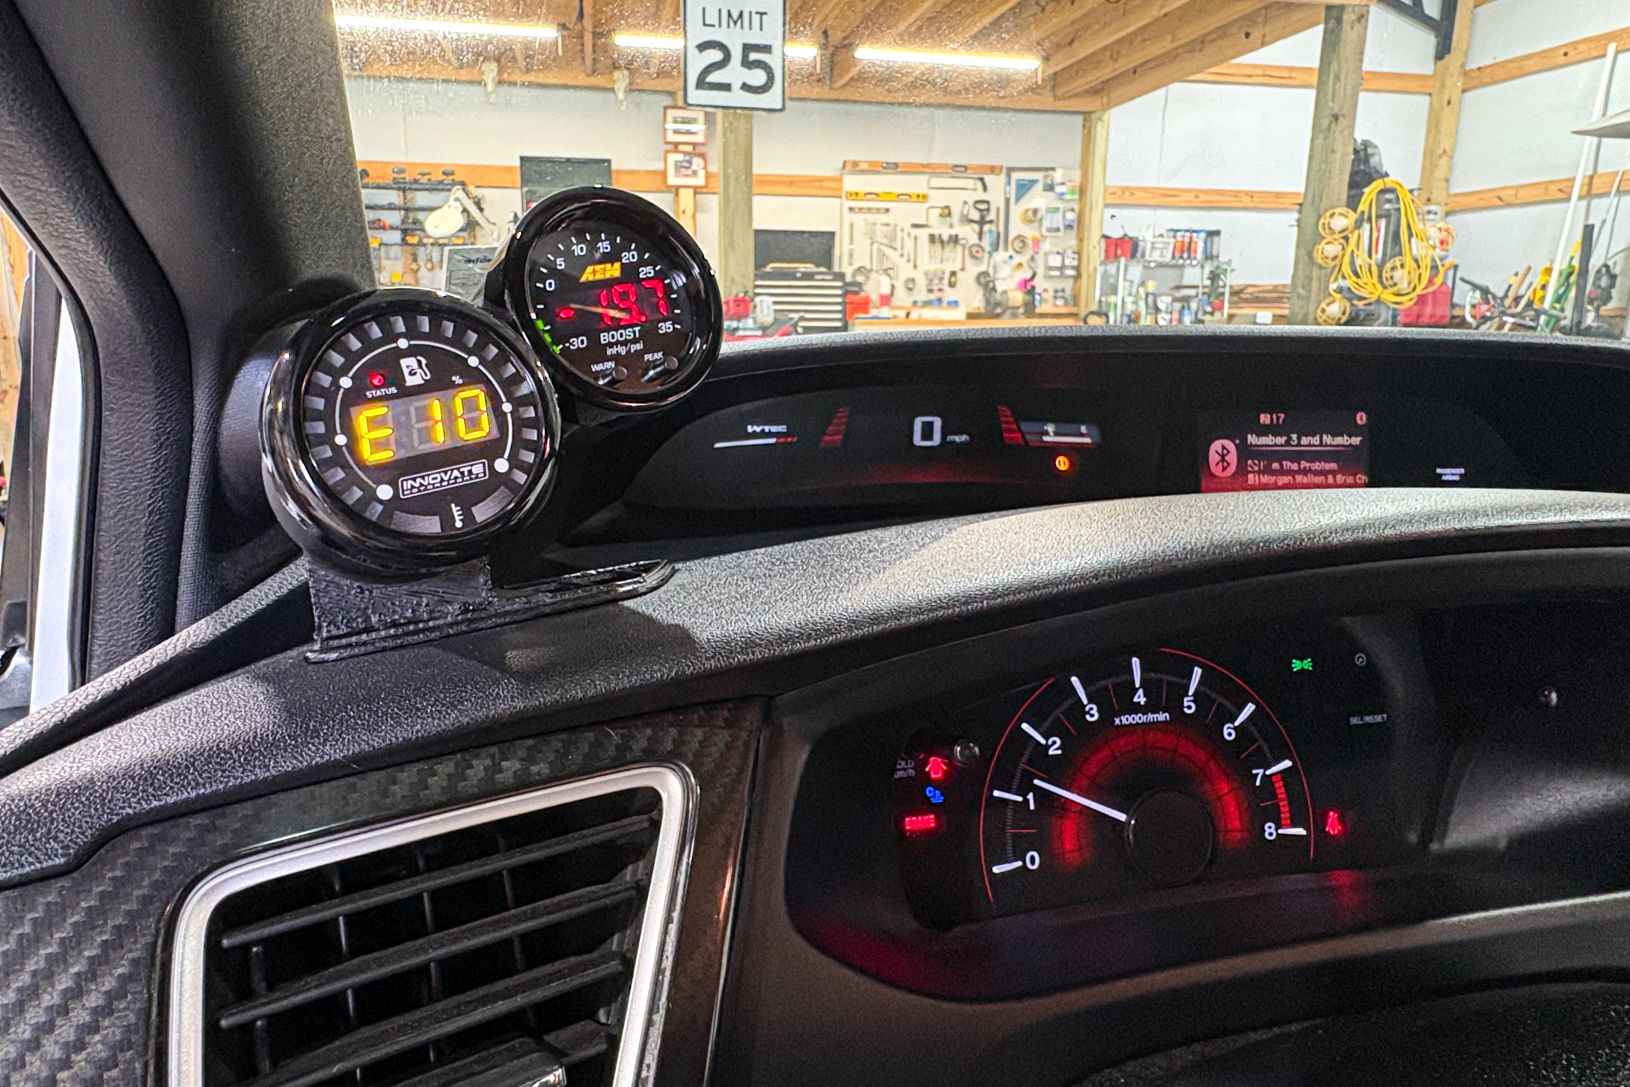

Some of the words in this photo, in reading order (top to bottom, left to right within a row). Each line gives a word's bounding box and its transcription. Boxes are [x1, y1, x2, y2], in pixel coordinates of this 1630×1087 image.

[702, 6, 768, 31] LIMIT
[695, 39, 775, 95] 25
[571, 244, 587, 256] 10
[597, 241, 611, 252] 15
[556, 258, 565, 269] 5
[621, 251, 638, 263] 20
[579, 261, 622, 282] AEM
[639, 267, 654, 278] 25
[545, 279, 555, 291] 0
[658, 321, 673, 333] 35
[565, 336, 587, 350] -30
[600, 327, 641, 344] BOOST
[606, 341, 644, 356] inHg/psi
[644, 351, 664, 362] PEAK
[591, 361, 615, 372] WARN
[366, 387, 397, 399] STATUS
[913, 416, 942, 446] 0
[947, 432, 970, 443] mph
[1247, 434, 1287, 445] Number
[1290, 433, 1298, 445] 3
[1301, 434, 1320, 445] and
[1322, 434, 1362, 445] Number
[1282, 461, 1299, 470] The
[1300, 461, 1338, 470] Problem
[402, 463, 484, 491] INNOVATE
[1133, 688, 1147, 705] 4
[1085, 704, 1099, 722] 3
[1183, 697, 1196, 714] 5
[1114, 711, 1170, 726] x1000r/min
[1223, 723, 1236, 741] 6
[1047, 736, 1062, 755] 2
[1252, 769, 1264, 786] 7
[1026, 792, 1035, 810] 1
[1264, 822, 1277, 840] 8
[1025, 851, 1041, 870] 0
